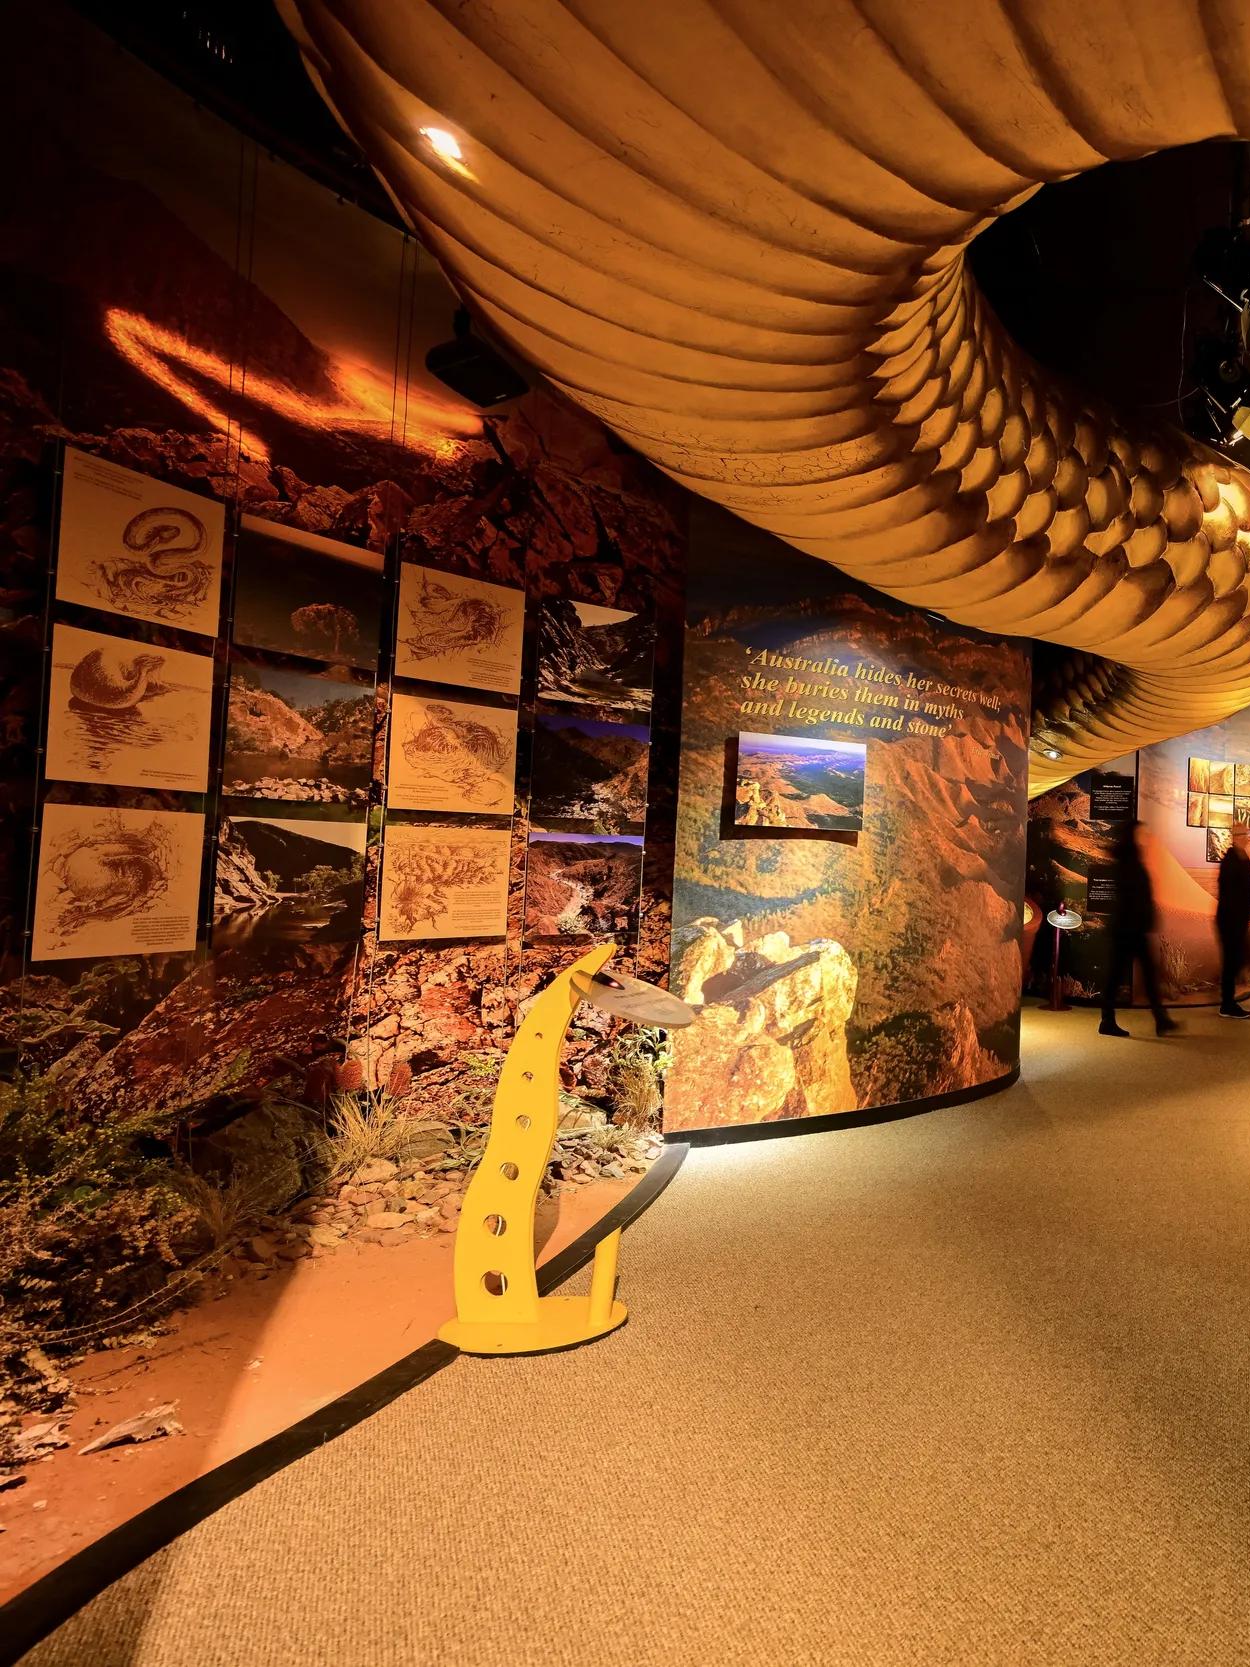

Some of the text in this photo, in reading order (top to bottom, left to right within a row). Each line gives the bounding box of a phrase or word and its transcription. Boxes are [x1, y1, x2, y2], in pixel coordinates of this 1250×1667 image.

[740, 672, 964, 720] she buries them in myths
[854, 662, 902, 686] hides
[906, 672, 933, 691] her
[935, 683, 977, 703] secrets
[979, 691, 1001, 713] well;
[740, 699, 785, 717] and
[788, 701, 865, 726] legends
[869, 715, 905, 731] and
